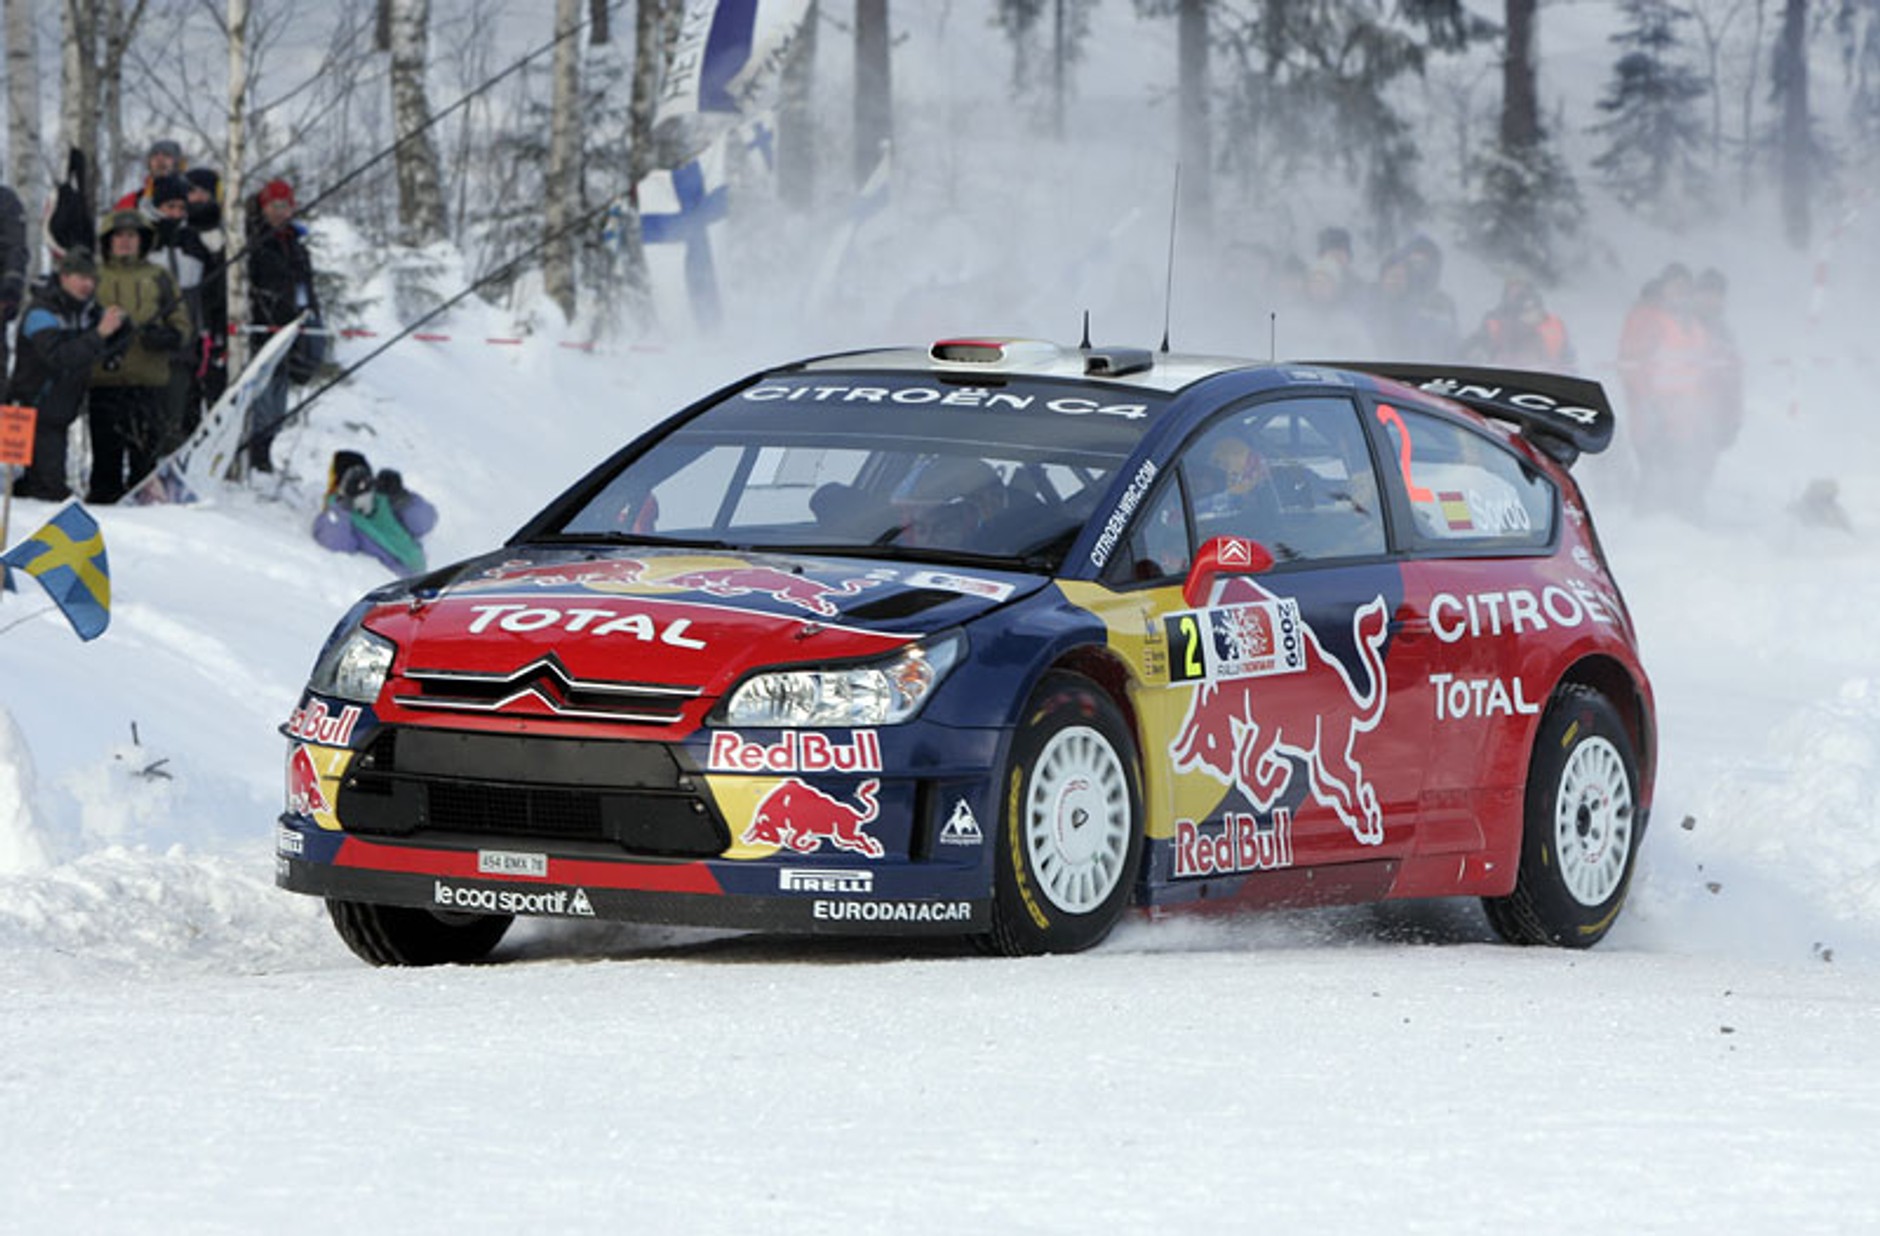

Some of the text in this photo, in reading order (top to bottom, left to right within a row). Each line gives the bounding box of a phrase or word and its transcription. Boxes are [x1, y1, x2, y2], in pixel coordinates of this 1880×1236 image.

[742, 386, 1148, 420] CITROËN C4
[1509, 393, 1599, 424] C4
[1376, 403, 1435, 504] 2
[468, 603, 707, 651] TOTAL
[1180, 616, 1202, 678] 2
[1277, 603, 1299, 668] 2009
[1428, 672, 1540, 721] TOTAL
[302, 701, 363, 747] Bull
[707, 728, 883, 772] Red Bull
[1175, 806, 1295, 877] Red Bull
[434, 879, 453, 905] le
[498, 890, 568, 914] sportif
[779, 867, 873, 893] PIRELLI
[813, 900, 972, 921] EURODATACAR
